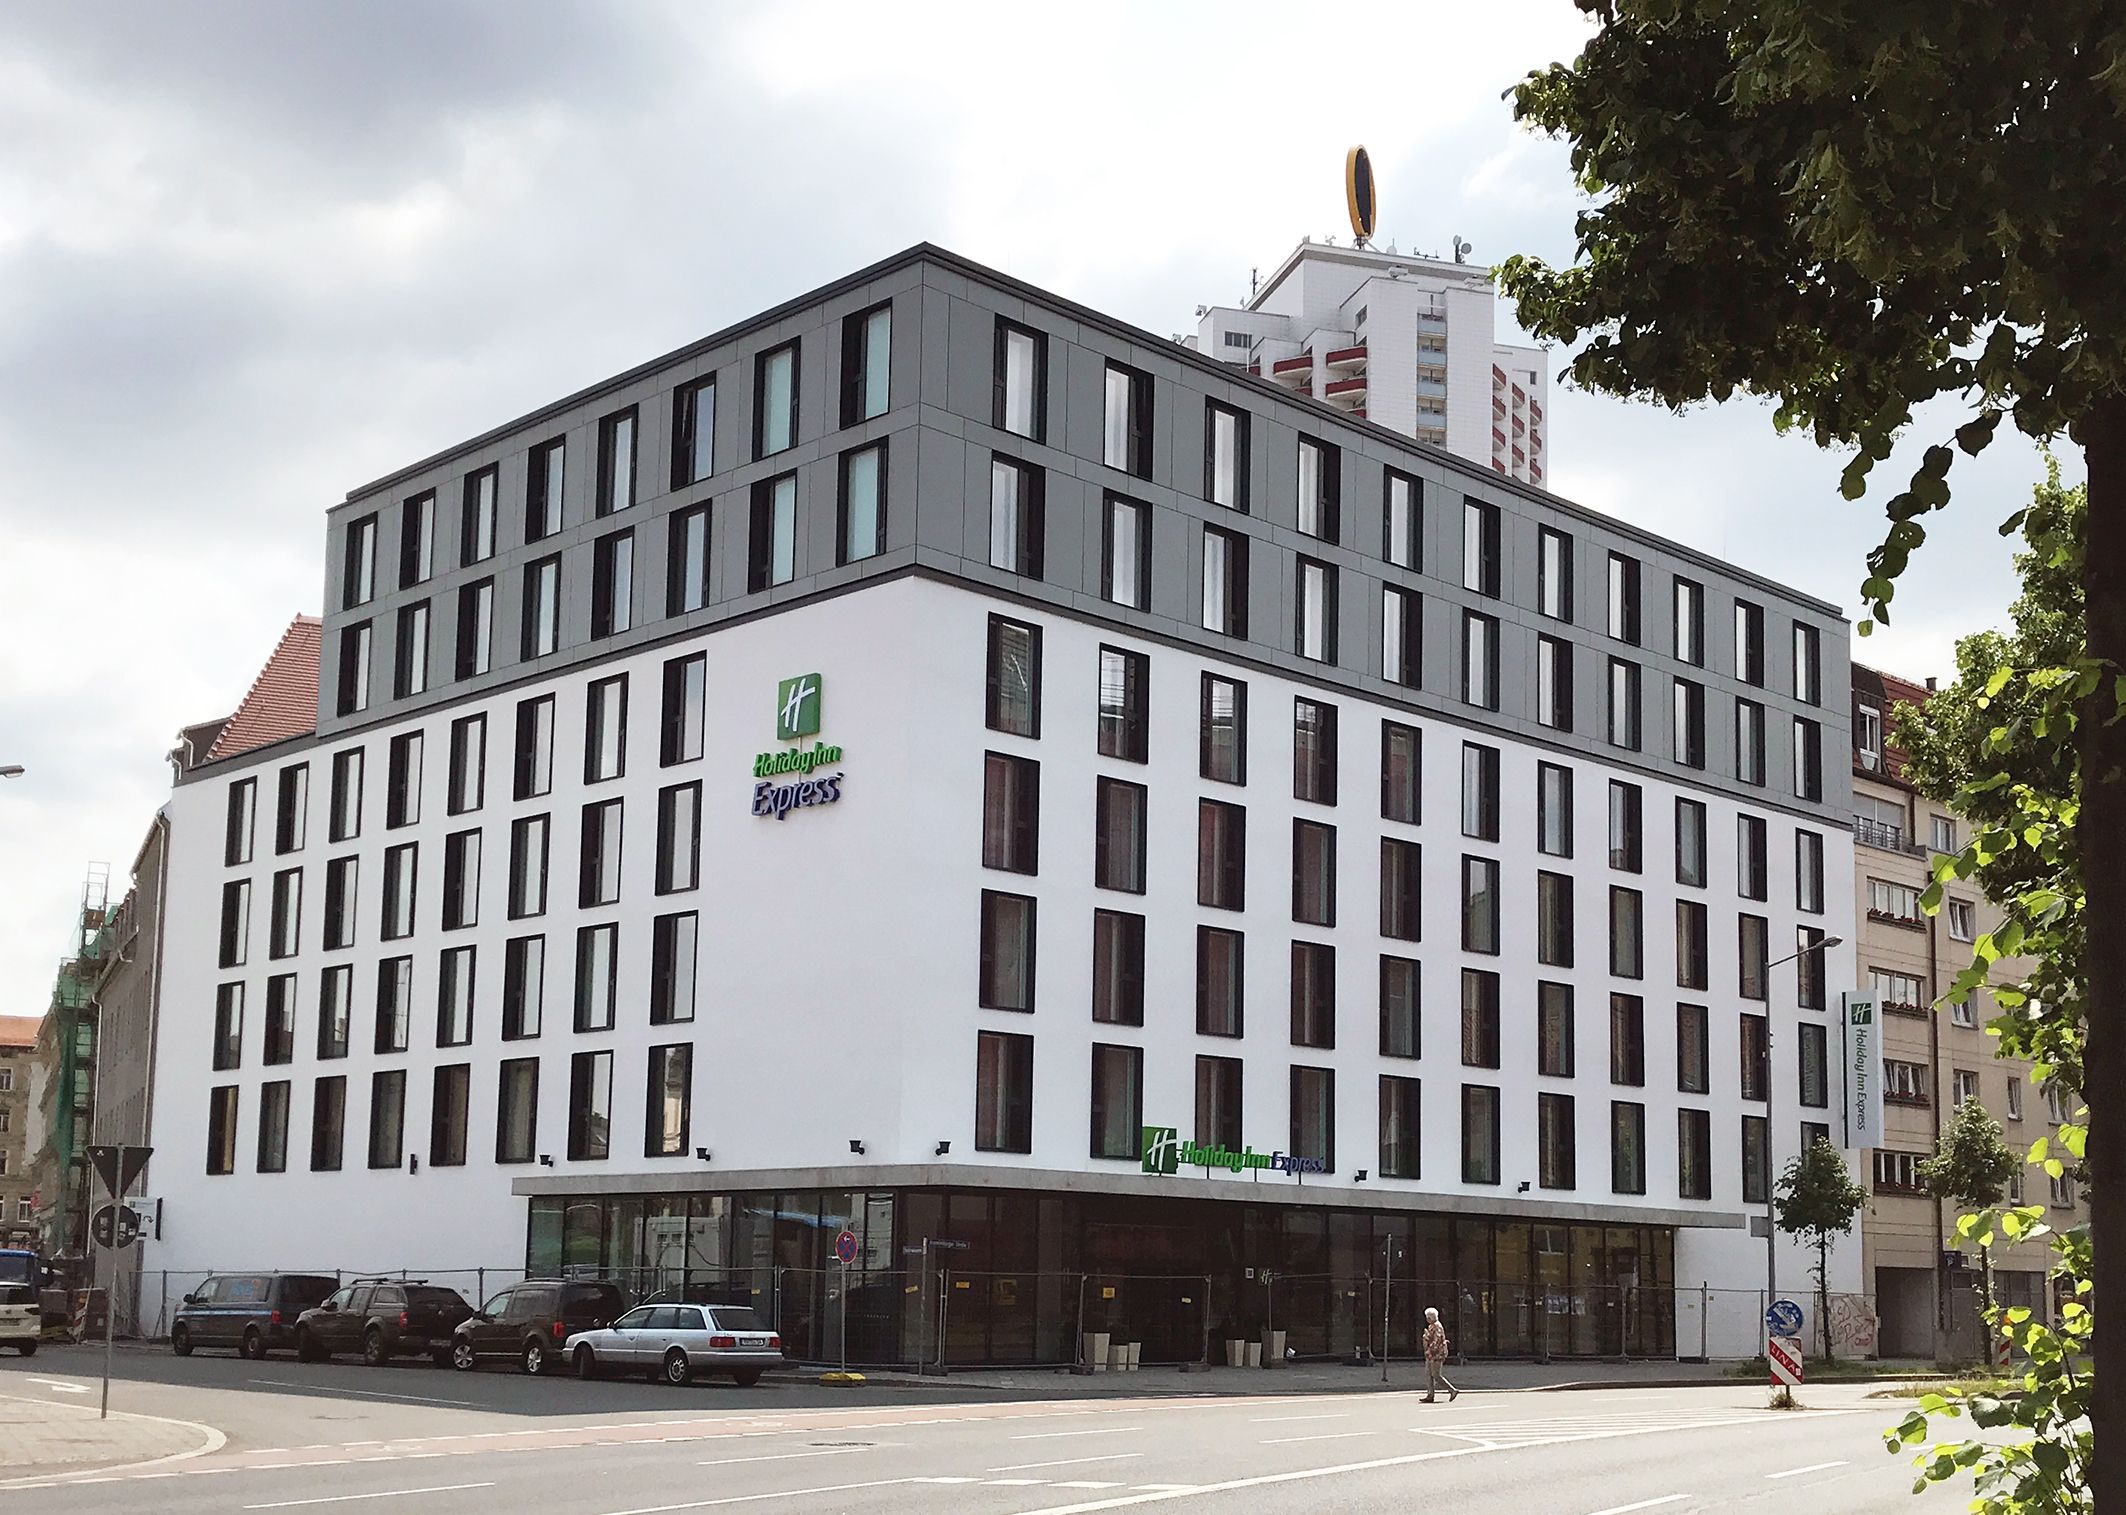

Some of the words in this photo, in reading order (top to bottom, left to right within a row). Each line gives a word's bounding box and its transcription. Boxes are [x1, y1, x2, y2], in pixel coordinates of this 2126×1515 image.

[753, 748, 813, 777] Holiday
[813, 741, 842, 766] Inn
[752, 777, 840, 820] Express
[1854, 1029, 1867, 1072] Holiday
[1855, 1072, 1867, 1091] Inn
[1855, 1092, 1867, 1131] Express
[1181, 1140, 1244, 1173] Holiday
[1244, 1146, 1271, 1169] Inn
[1271, 1151, 1325, 1176] Express
[1771, 1345, 1796, 1373] LINA
